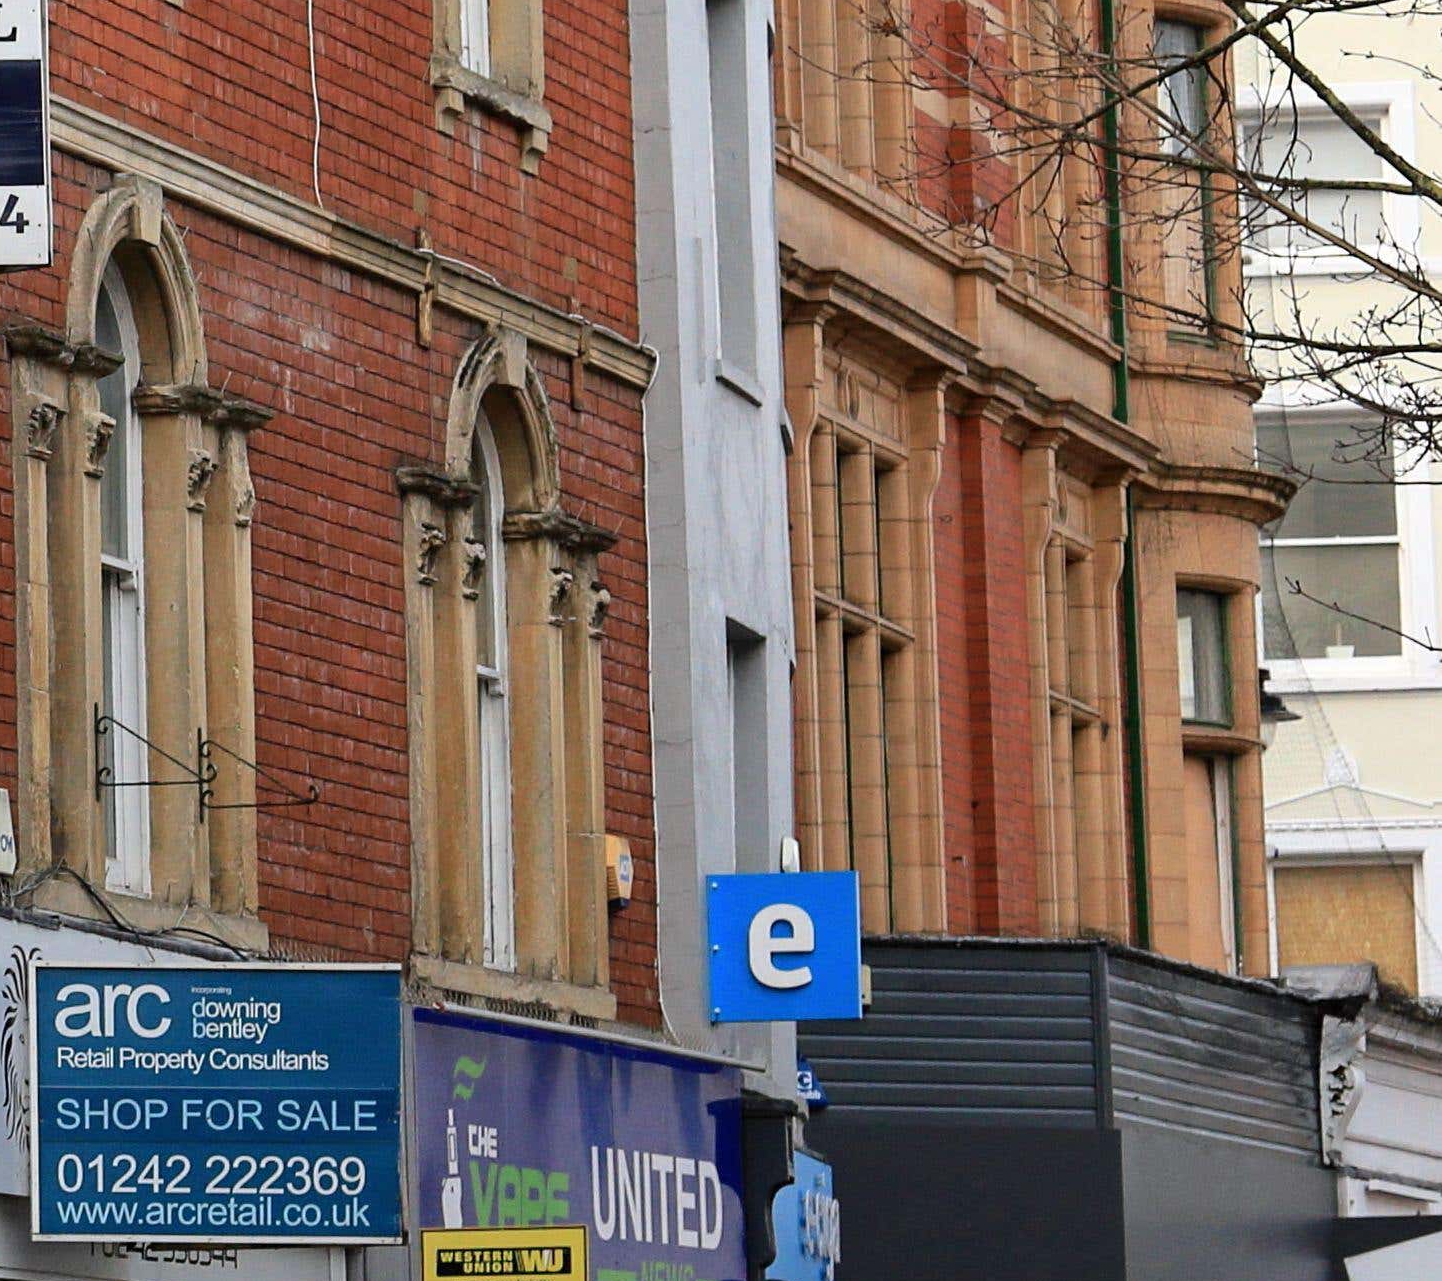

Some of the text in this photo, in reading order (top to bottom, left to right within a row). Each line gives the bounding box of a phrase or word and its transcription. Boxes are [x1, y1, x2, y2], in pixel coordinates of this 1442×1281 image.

[748, 903, 815, 989] e
[54, 982, 172, 1039] arc
[191, 996, 281, 1024] downing
[192, 1017, 269, 1045] bentley
[56, 1047, 330, 1075] Retail Property Consultants
[56, 1097, 378, 1132] SHOP FOR SALE
[57, 1154, 367, 1196] 01242 222369
[57, 1197, 371, 1227] www.arcretail.co.uk
[590, 1146, 724, 1251] UNITED
[440, 1250, 514, 1263] WESTERN
[463, 1262, 514, 1273] UNION
[521, 1249, 564, 1272] WU
